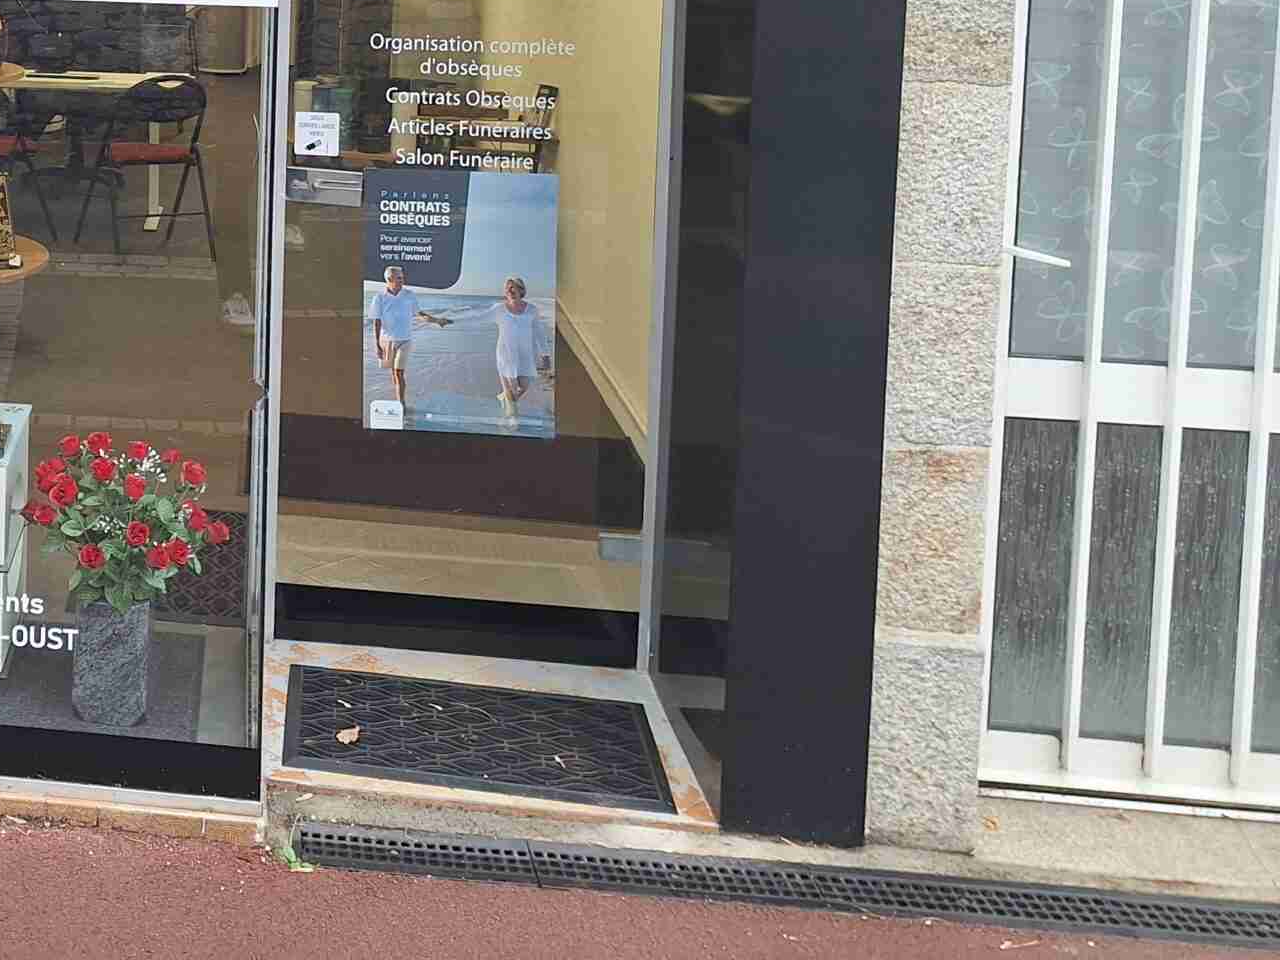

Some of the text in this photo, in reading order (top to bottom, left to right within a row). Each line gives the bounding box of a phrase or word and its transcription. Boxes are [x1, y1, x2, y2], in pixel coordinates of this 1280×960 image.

[369, 33, 576, 57] Organisation complète
[420, 58, 522, 80] d'obsèques
[385, 86, 461, 107] Contrats
[388, 117, 454, 137] Articles
[395, 148, 535, 170] Salon Funéraire
[380, 200, 450, 213] CONTRATS
